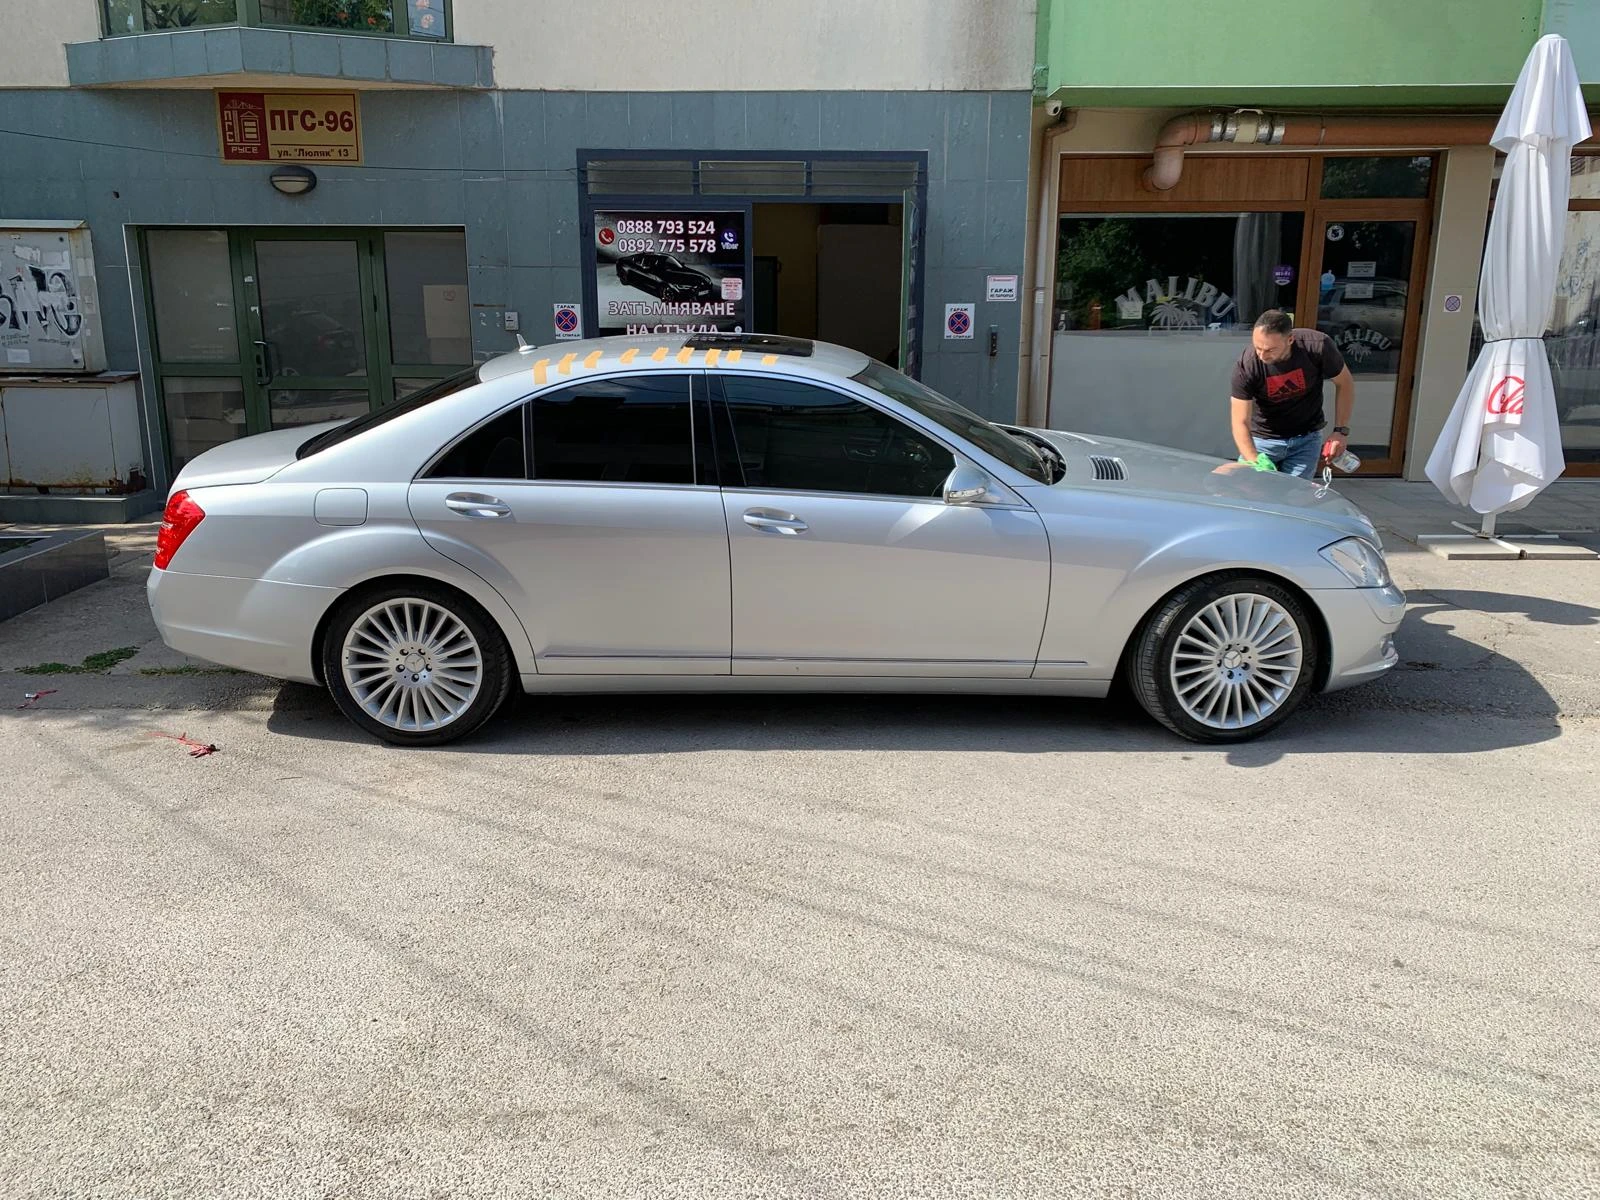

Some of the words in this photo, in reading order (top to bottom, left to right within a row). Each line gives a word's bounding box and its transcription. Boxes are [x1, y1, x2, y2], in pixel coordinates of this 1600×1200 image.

[269, 109, 354, 132] ПГС-96
[231, 146, 259, 154] РУСЕ
[277, 149, 292, 158] ул.
[338, 149, 349, 157] 13
[616, 220, 654, 234] 0888
[657, 220, 684, 234] 793
[688, 220, 716, 235] 524
[618, 238, 654, 253] 0892
[658, 239, 685, 253] 775
[689, 239, 717, 253] 578
[1114, 275, 1238, 319] MALIBU
[608, 301, 736, 316] ЗАТЪМНЯВАНЕ
[626, 324, 649, 336] НА
